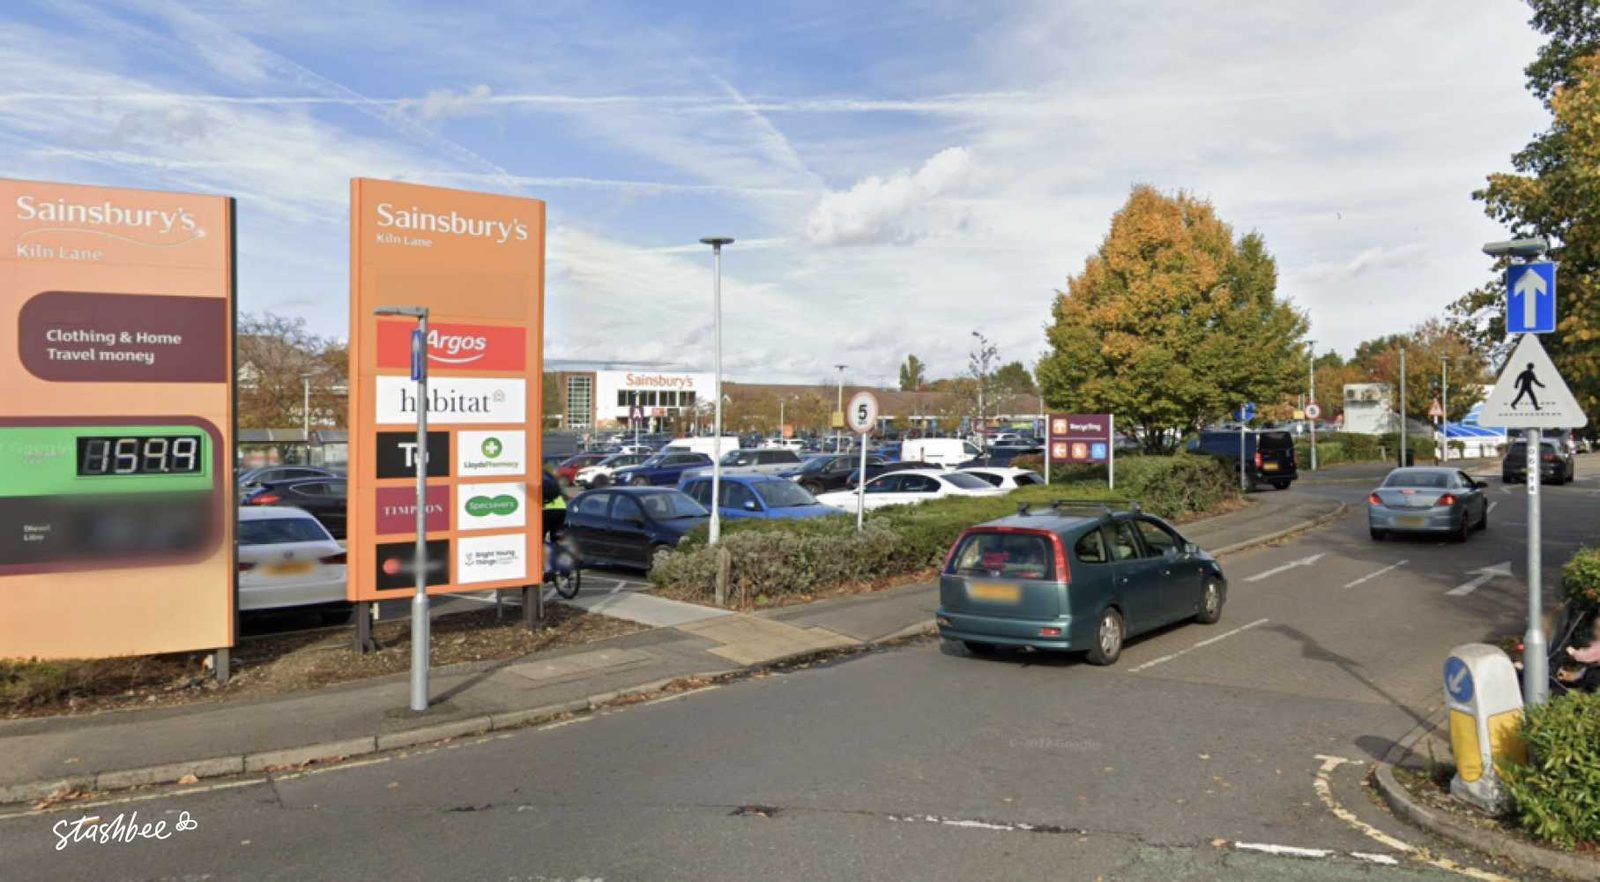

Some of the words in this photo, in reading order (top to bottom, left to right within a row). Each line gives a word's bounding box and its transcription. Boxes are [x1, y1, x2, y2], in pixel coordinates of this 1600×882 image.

[16, 196, 196, 233] Sainsbury's
[376, 203, 528, 243] Sainsbury's
[376, 233, 400, 244] Kiln
[404, 236, 432, 247] Lane
[16, 244, 54, 258] Kiln
[59, 246, 102, 260] Lane
[46, 330, 116, 346] Clothing
[120, 331, 132, 344] &
[136, 332, 182, 345] Home
[427, 330, 486, 354] Argos
[47, 348, 95, 361] Travel
[99, 350, 155, 364] money
[626, 373, 693, 389] Sainsbury's
[633, 408, 641, 418] A
[858, 404, 867, 420] 5
[1070, 423, 1102, 432] Recycling
[384, 504, 443, 516] TIMPON
[469, 500, 514, 511] Specsavers
